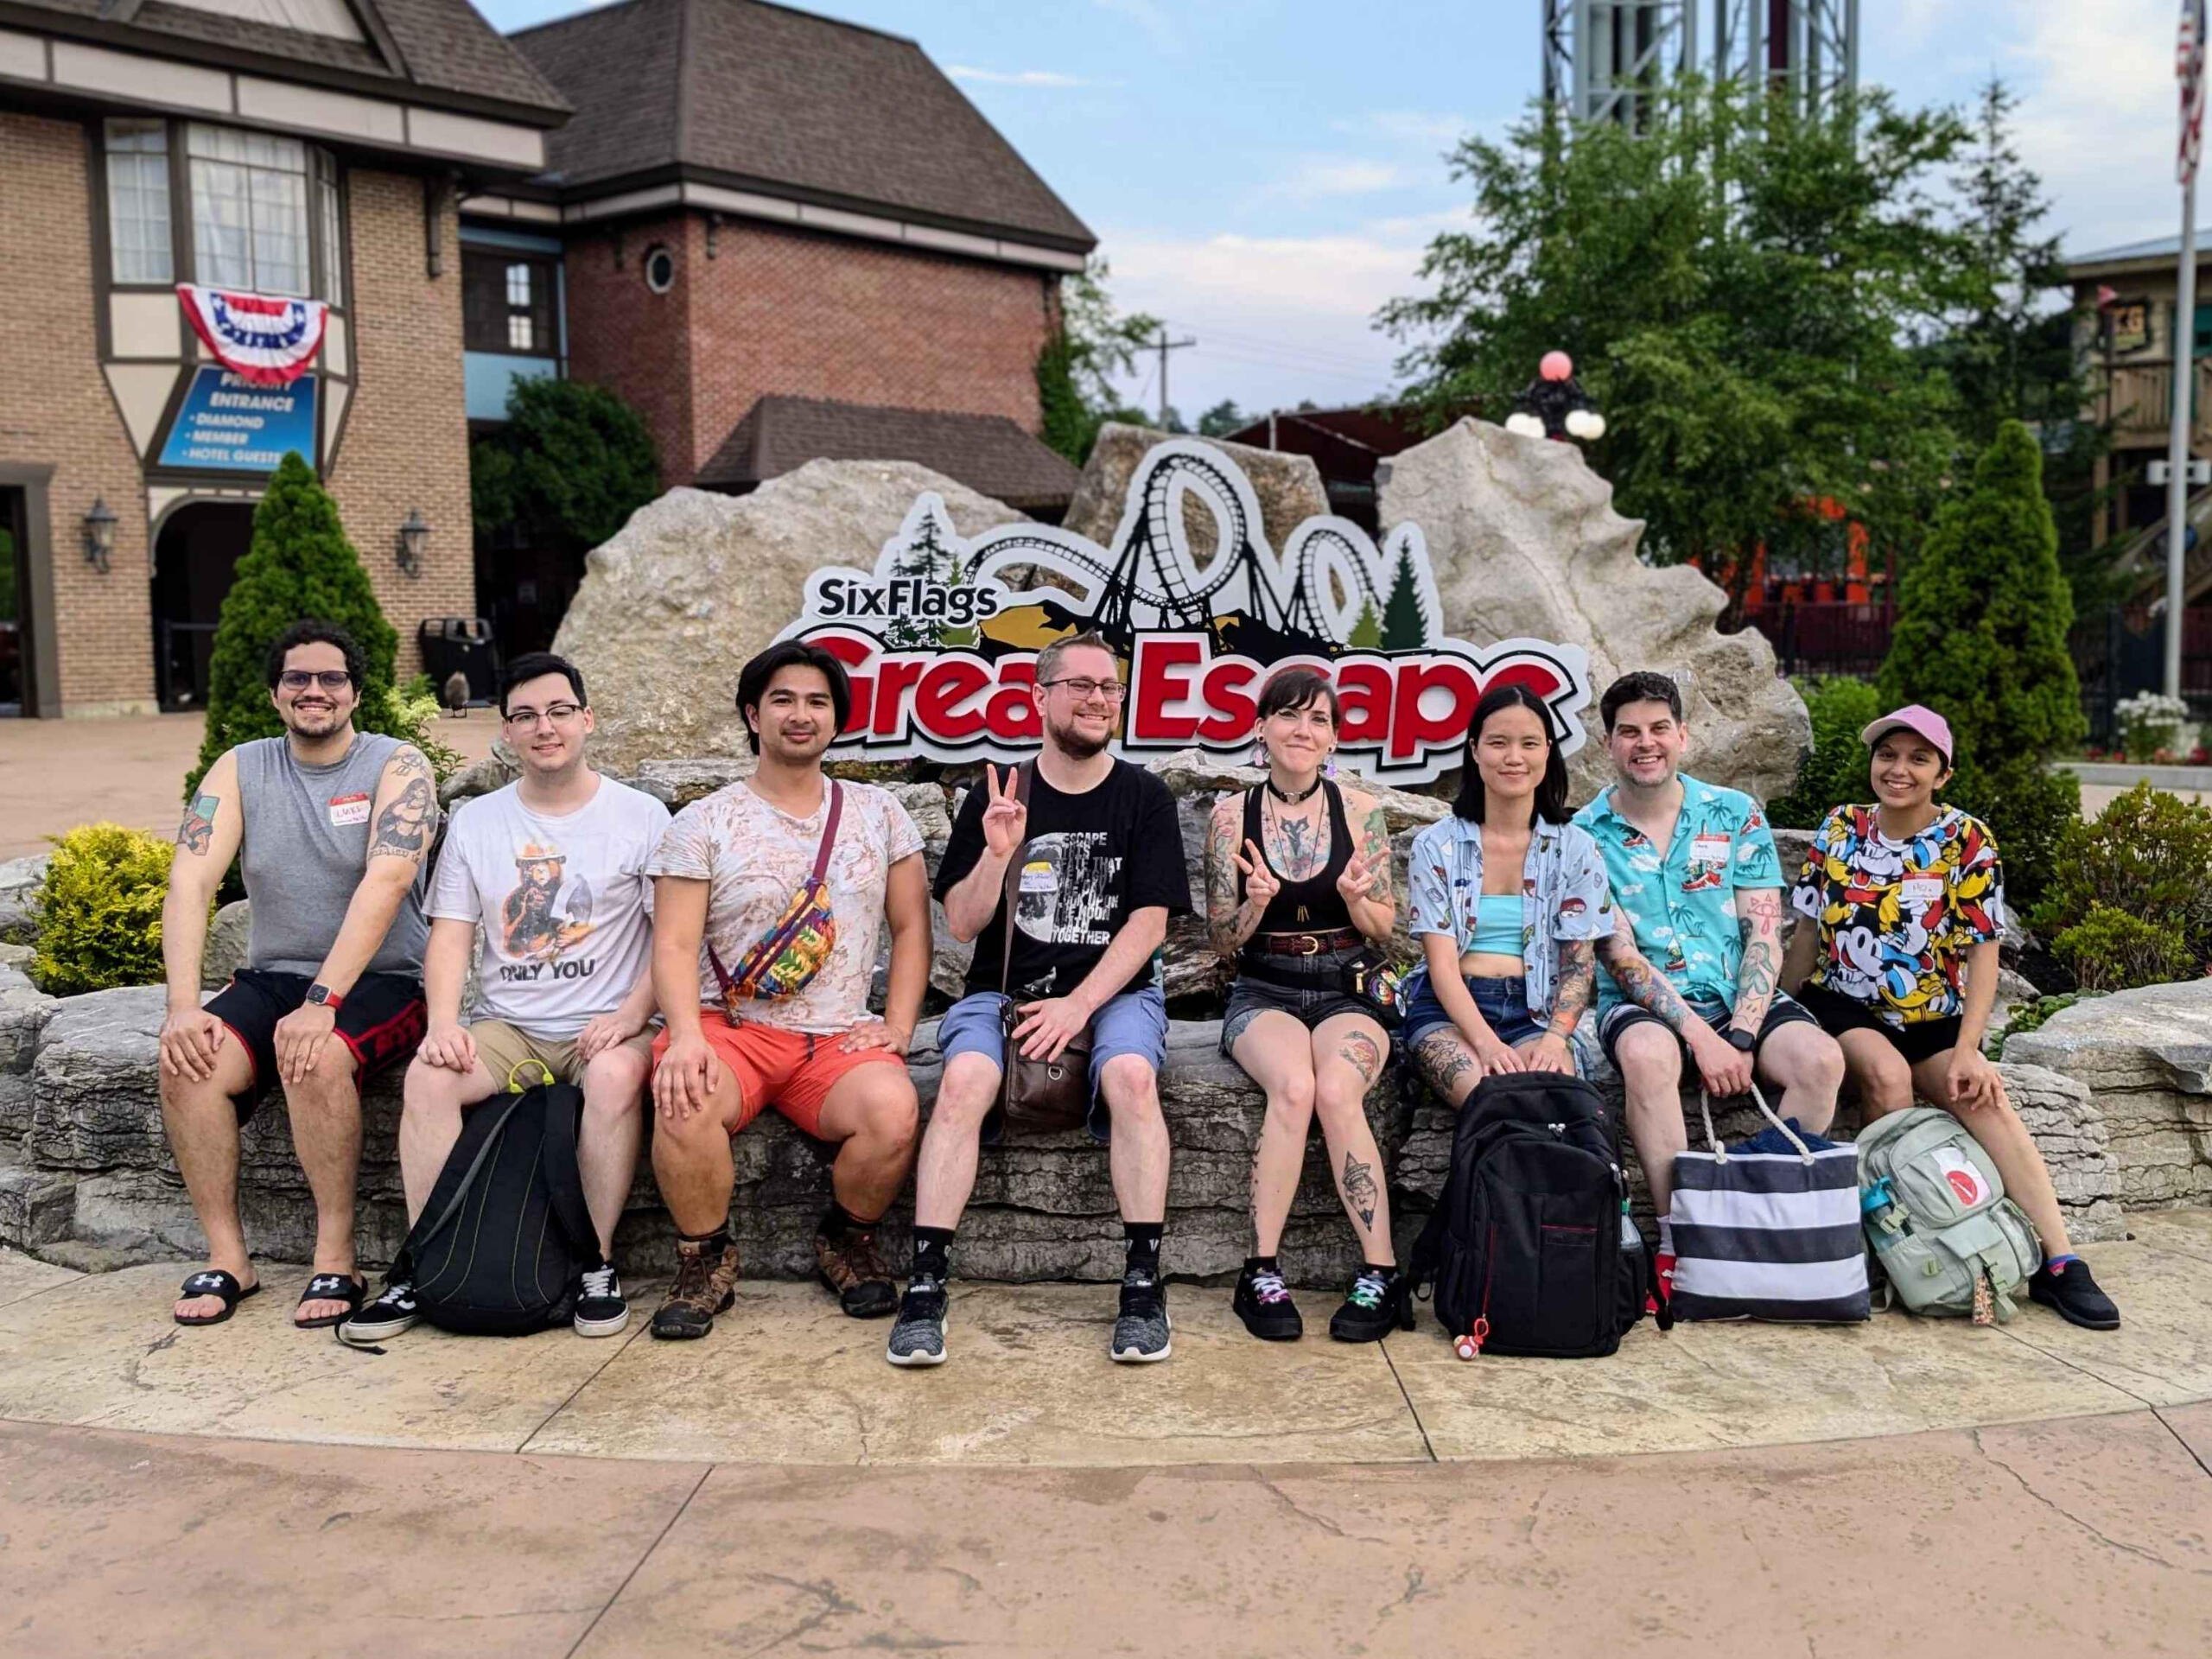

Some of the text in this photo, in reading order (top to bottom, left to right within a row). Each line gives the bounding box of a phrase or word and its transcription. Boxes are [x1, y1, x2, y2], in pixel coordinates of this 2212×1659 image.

[210, 391, 294, 412] ENTRANCE
[196, 412, 264, 429] DIAMOND
[193, 430, 248, 444] MEMBER
[189, 448, 230, 461] HOTEL
[808, 636, 1044, 738] Grea
[1060, 832, 1108, 845] ESCAPE
[1052, 928, 1110, 944] TOGETHER
[550, 958, 595, 980] YOU
